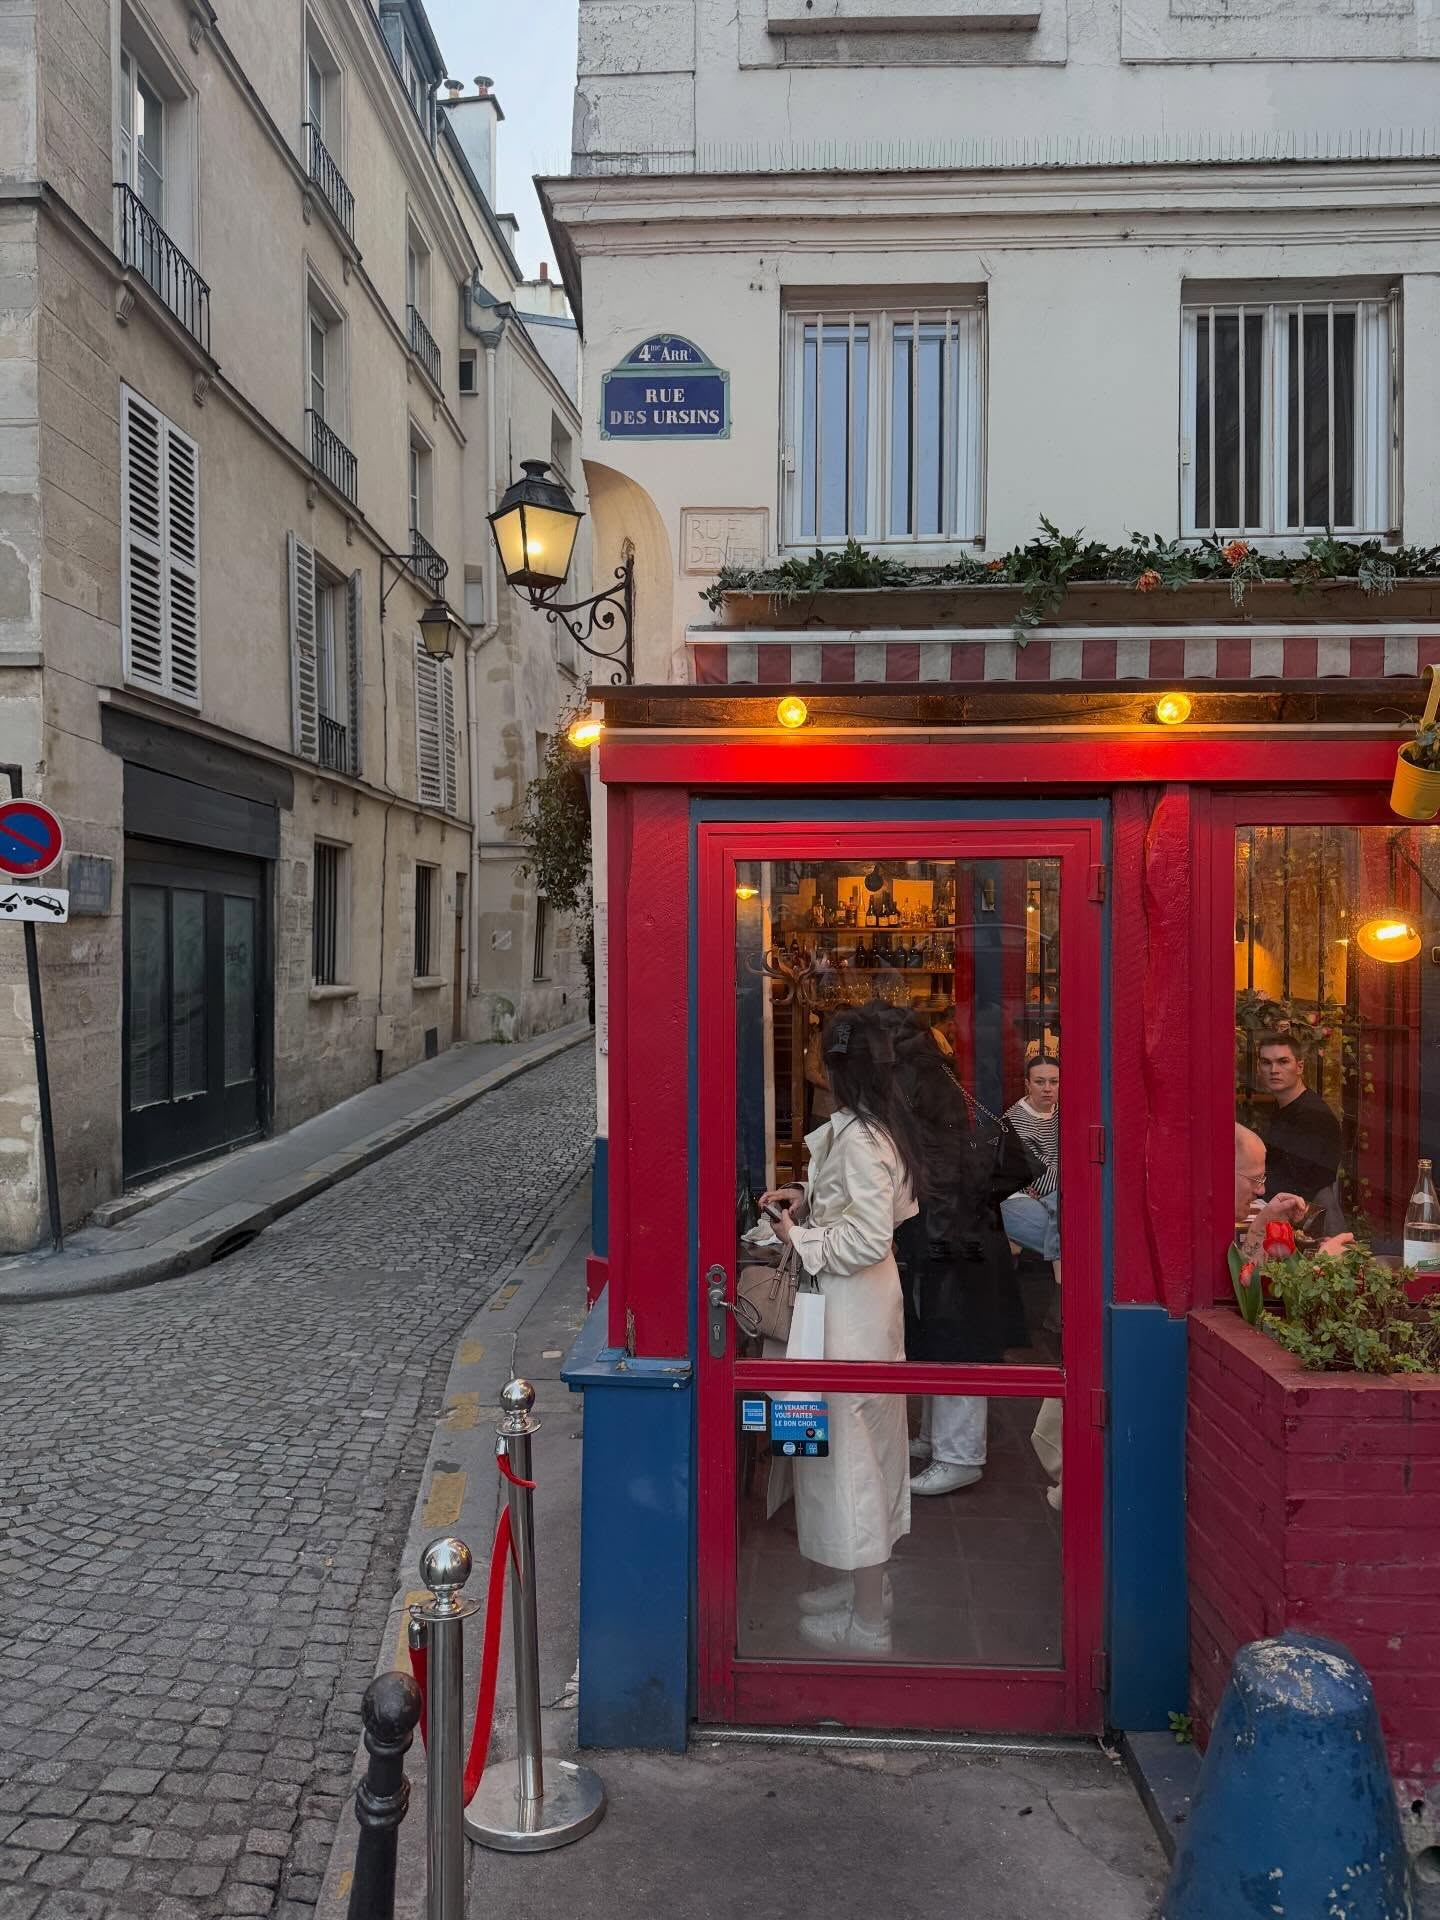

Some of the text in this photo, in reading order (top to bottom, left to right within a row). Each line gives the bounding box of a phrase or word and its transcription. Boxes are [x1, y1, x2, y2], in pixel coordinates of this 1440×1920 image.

[645, 388, 685, 403] RUE
[609, 409, 720, 424] DES URSINS
[691, 518, 743, 540] RUE
